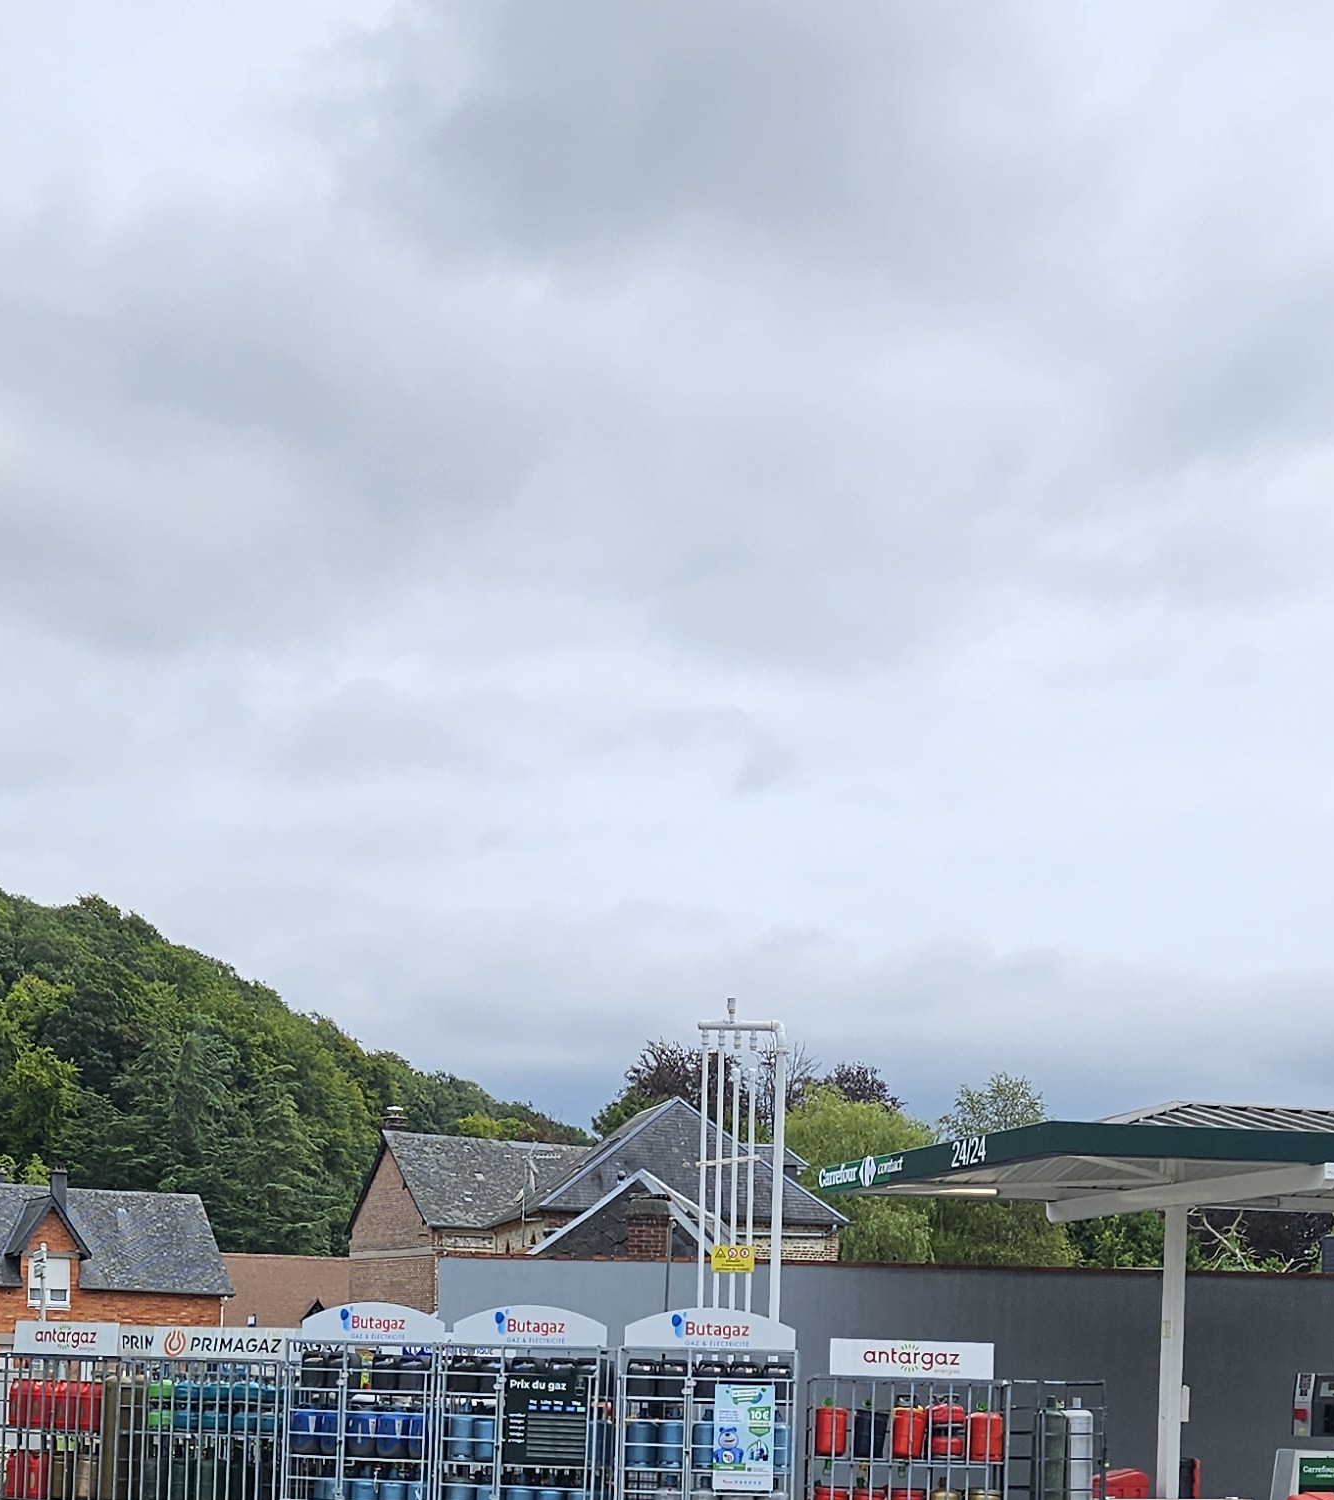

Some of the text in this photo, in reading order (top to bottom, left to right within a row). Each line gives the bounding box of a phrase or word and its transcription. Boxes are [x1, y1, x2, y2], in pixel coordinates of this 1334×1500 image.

[951, 1135, 986, 1168] 24/24
[818, 1156, 905, 1188] Carrefour contact
[352, 1315, 405, 1332] Butagaz
[507, 1318, 565, 1336] Butagaz
[685, 1321, 750, 1340] Butagaz
[35, 1328, 98, 1349] antargaz
[190, 1337, 282, 1353] PRIMAGAZ
[863, 1347, 960, 1371] antargaz
[509, 1379, 567, 1392] Prix du gaz
